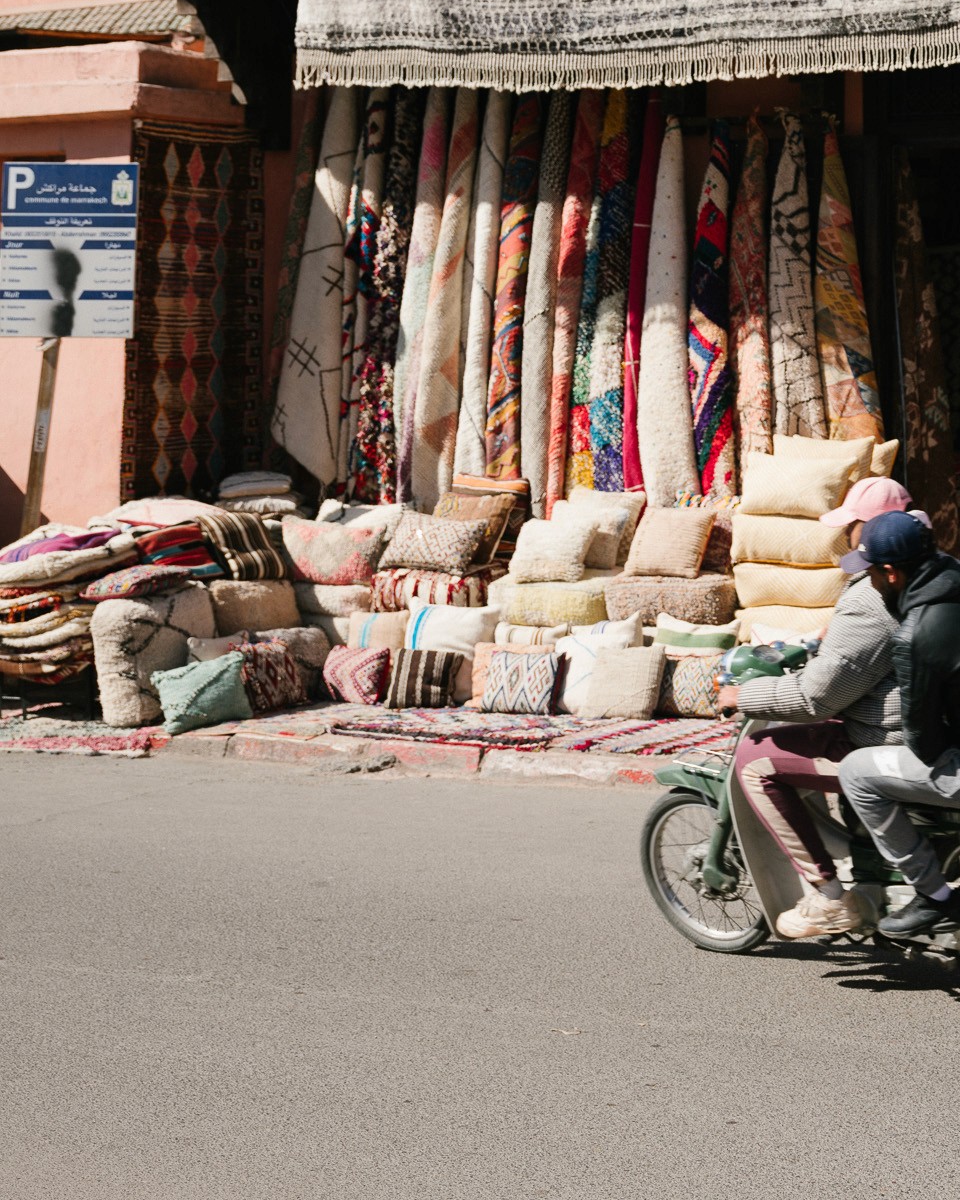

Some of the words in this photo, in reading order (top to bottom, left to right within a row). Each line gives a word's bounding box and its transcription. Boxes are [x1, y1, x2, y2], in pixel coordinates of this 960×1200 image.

[7, 166, 36, 210] P
[36, 183, 67, 195] مراكش
[68, 183, 97, 194] جماعة
[60, 196, 70, 204] de
[5, 241, 24, 249] Jour
